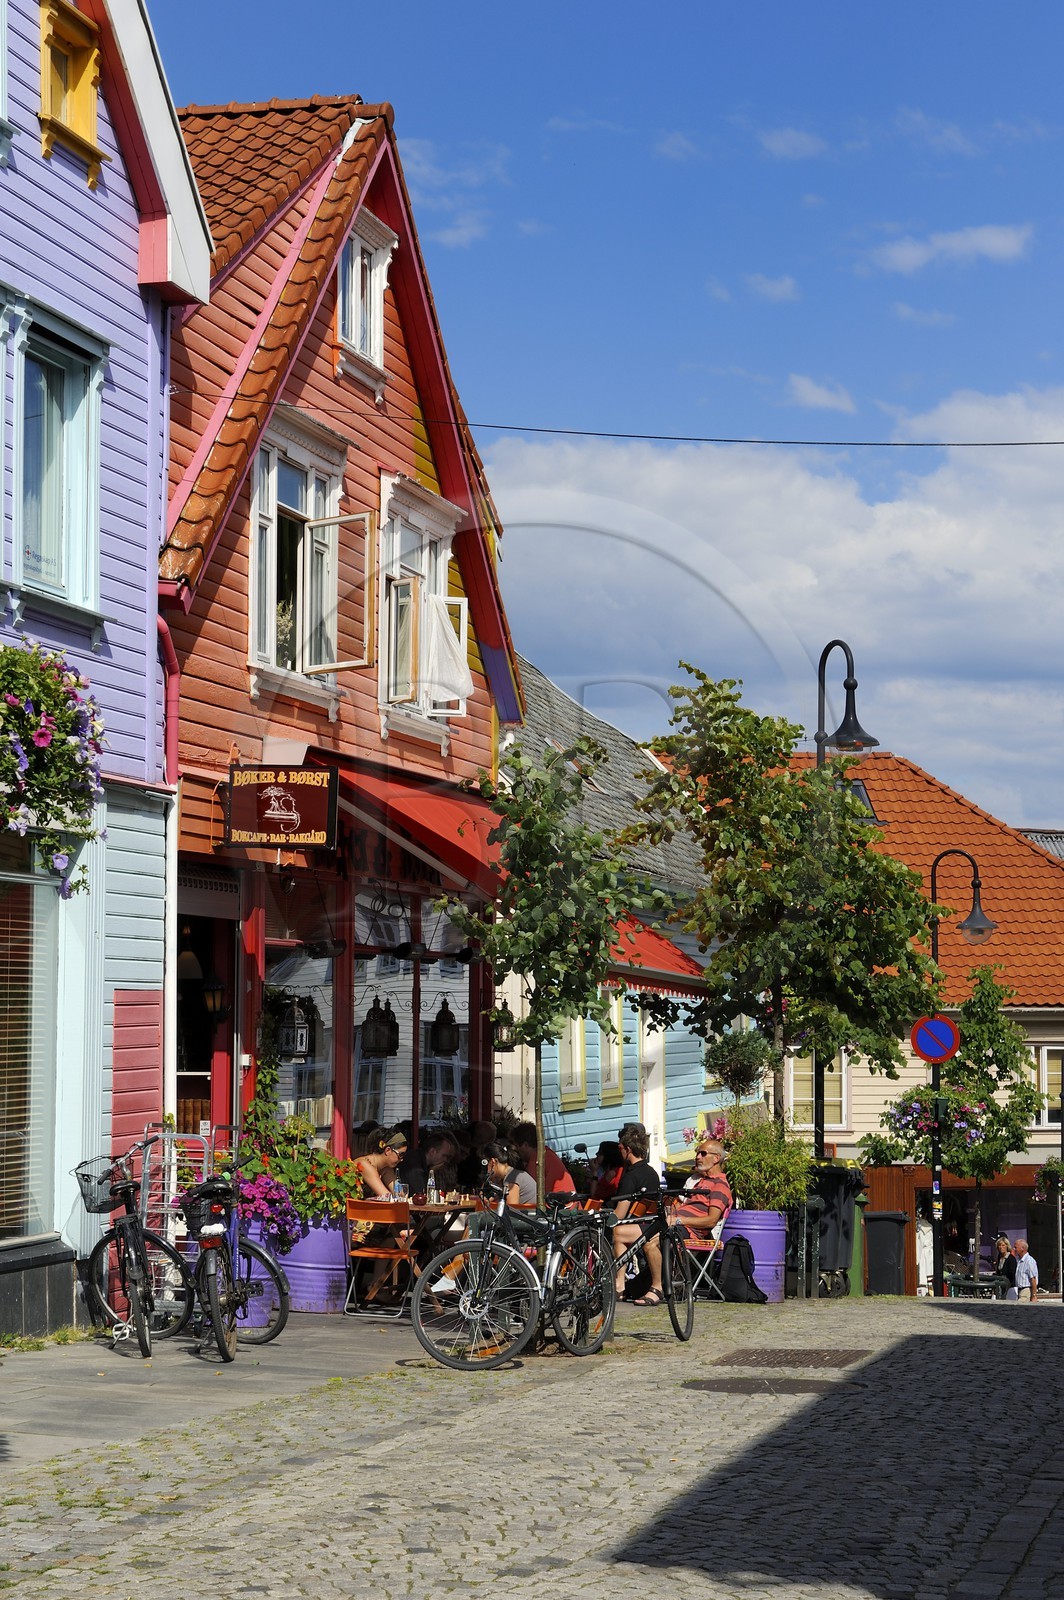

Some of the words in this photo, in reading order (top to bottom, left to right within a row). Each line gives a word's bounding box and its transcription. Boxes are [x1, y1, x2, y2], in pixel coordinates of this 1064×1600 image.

[233, 770, 276, 787] BØKER
[277, 771, 287, 783] &
[289, 771, 330, 788] BØRST
[270, 833, 287, 843] BAR
[289, 829, 327, 844] BAKGÅRD
